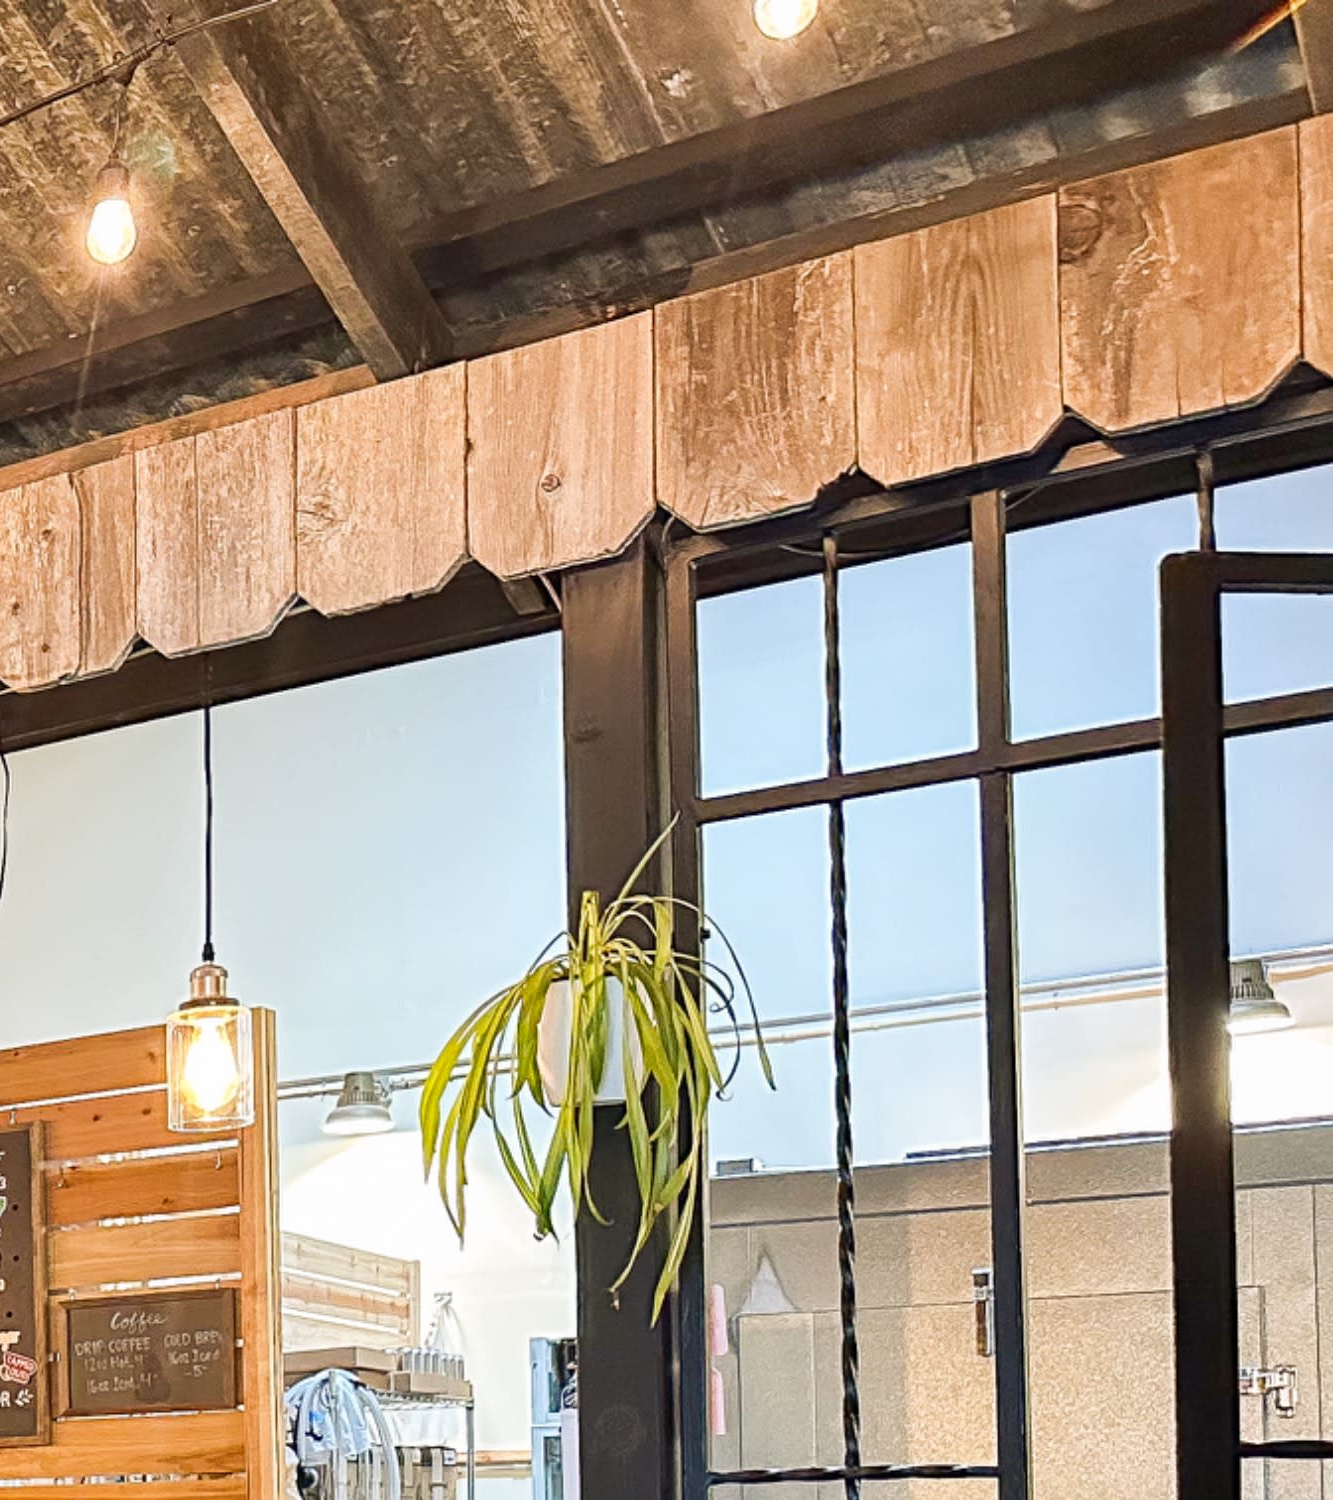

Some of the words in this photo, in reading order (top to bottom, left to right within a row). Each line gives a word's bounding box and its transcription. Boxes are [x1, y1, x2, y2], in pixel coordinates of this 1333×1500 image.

[110, 1312, 167, 1334] Coffee
[74, 1340, 102, 1357] DRIP
[108, 1337, 151, 1353] COFFEE
[164, 1334, 191, 1348] COLD
